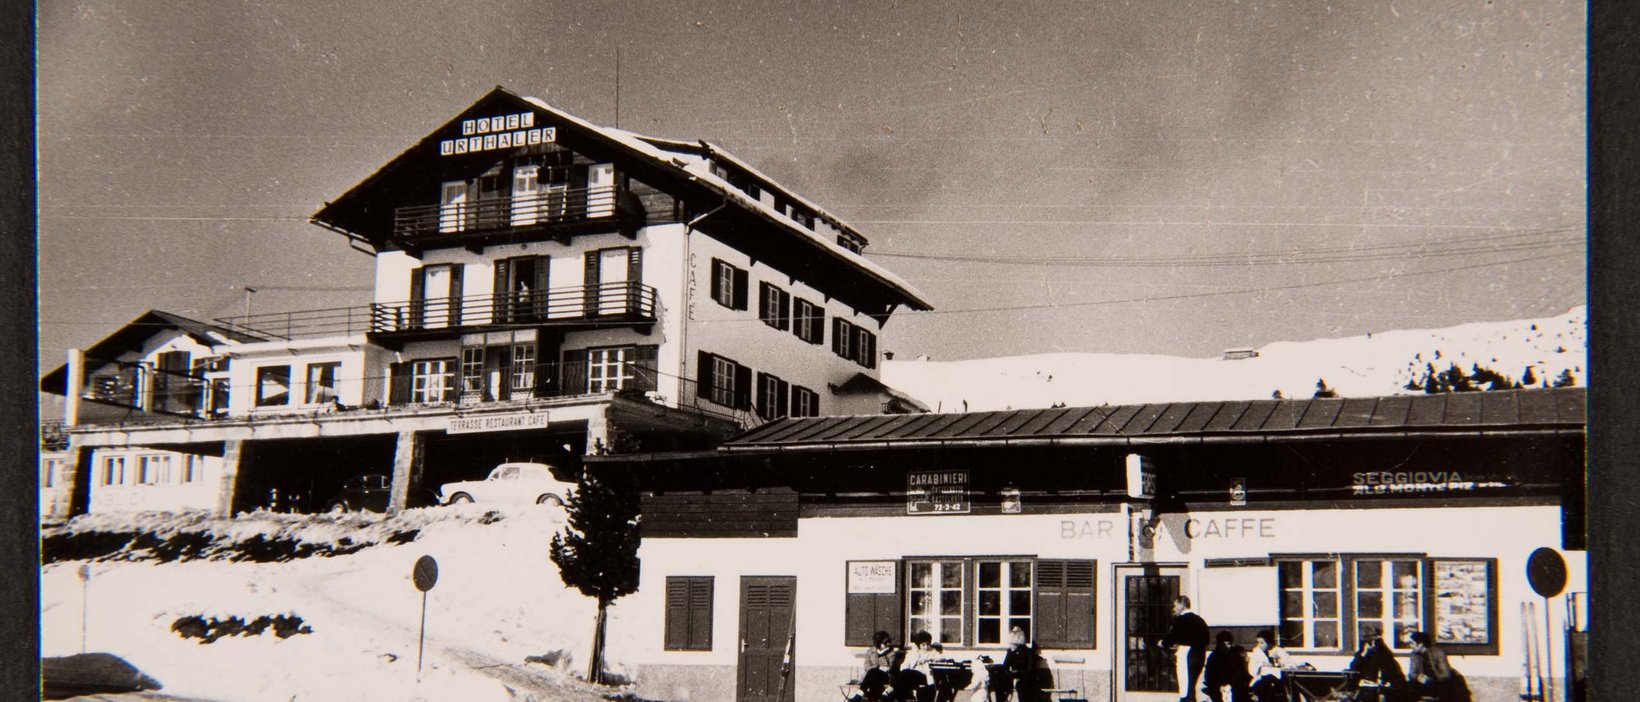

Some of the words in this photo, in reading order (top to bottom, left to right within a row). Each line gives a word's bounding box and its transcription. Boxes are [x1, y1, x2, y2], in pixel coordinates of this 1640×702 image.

[464, 113, 532, 135] HOTEL
[442, 129, 555, 154] URTHALER
[450, 419, 482, 431] TERRASSE
[486, 416, 525, 429] RESTAURANT
[909, 472, 967, 486] CARABINIERI
[1352, 471, 1463, 485] SEGGIOVIA
[1060, 520, 1114, 540] BAR
[1184, 518, 1276, 539] CAFFE
